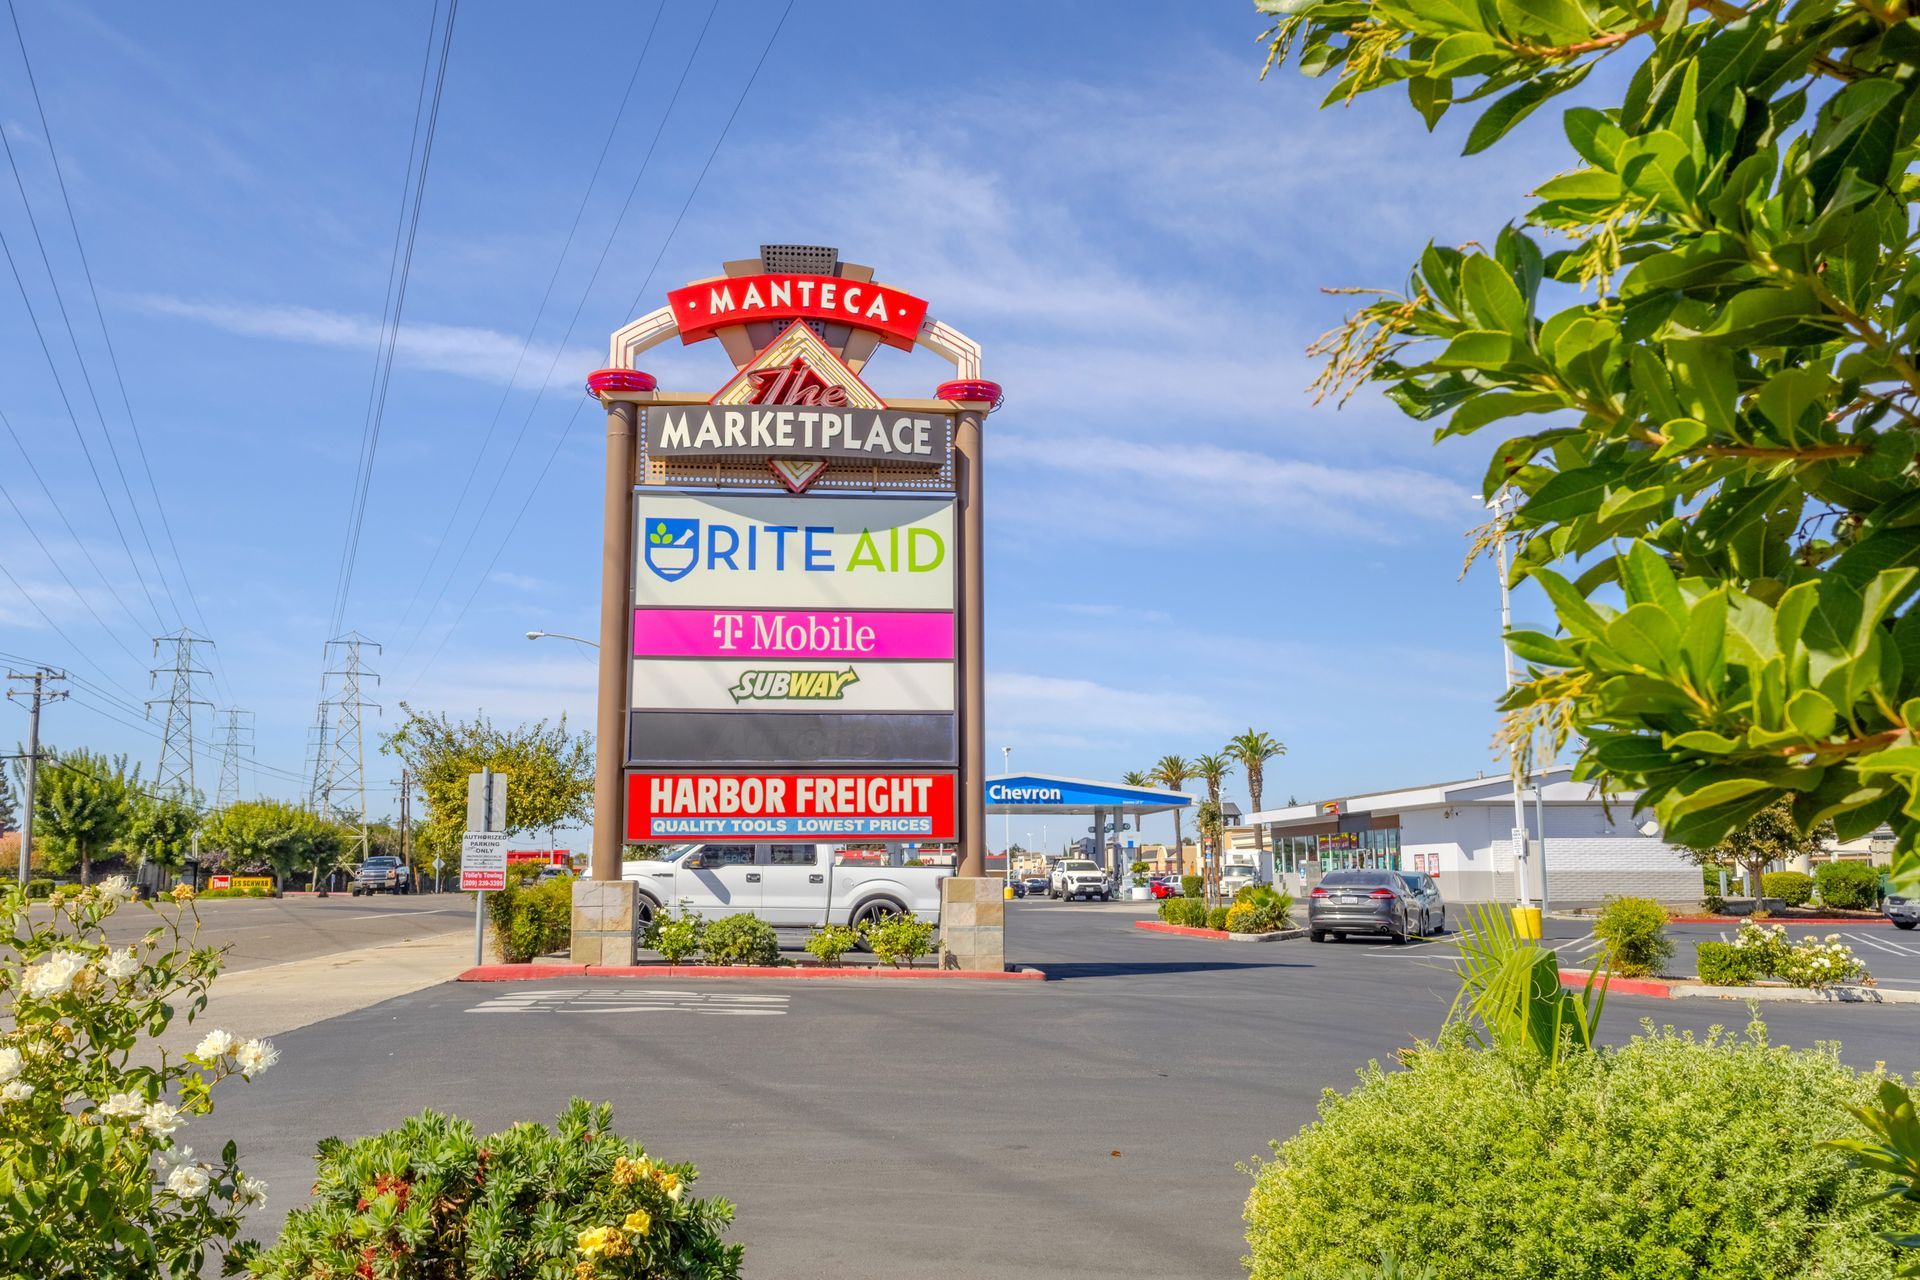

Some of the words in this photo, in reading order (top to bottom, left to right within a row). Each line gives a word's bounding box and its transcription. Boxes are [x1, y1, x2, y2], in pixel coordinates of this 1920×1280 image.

[709, 279, 889, 322] MANTECA
[747, 363, 849, 408] The
[659, 410, 933, 456] MARKETPLACE
[707, 524, 835, 572] RITE
[846, 526, 946, 573] AID
[730, 666, 859, 703] SUBWAY
[650, 778, 787, 814] HARBOR
[795, 777, 932, 813] FREIGHT
[989, 785, 1061, 801] Chevron
[652, 819, 726, 834] QUALITY
[730, 819, 787, 832] TOOLS
[797, 819, 865, 832] LOWEST
[869, 818, 930, 832] PRICES
